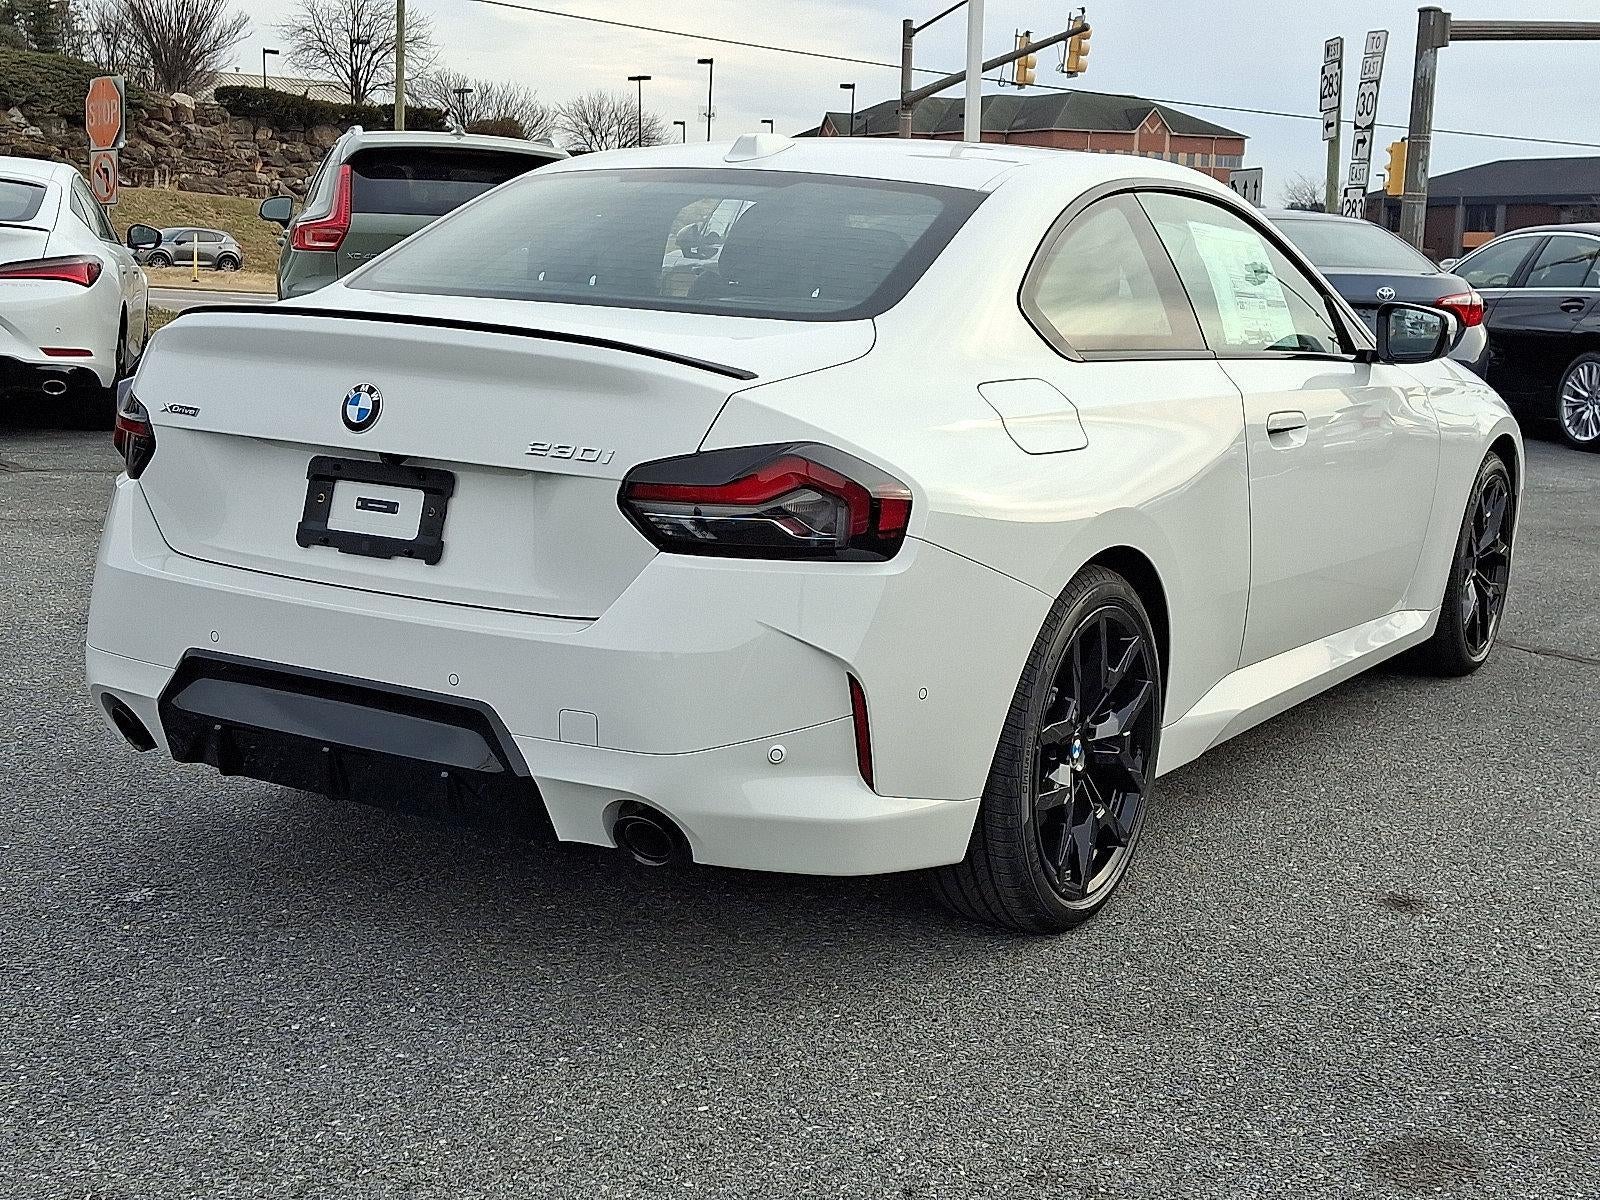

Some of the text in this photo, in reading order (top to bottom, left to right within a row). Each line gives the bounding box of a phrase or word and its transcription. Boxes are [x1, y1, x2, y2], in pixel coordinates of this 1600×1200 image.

[1370, 36, 1381, 50] TO
[1363, 60, 1379, 76] EAST
[1322, 72, 1339, 99] 283
[88, 99, 118, 127] STOP
[1358, 91, 1374, 117] 30
[1350, 166, 1365, 182] EAST
[1345, 198, 1363, 218] 283
[525, 441, 615, 465] 230i
